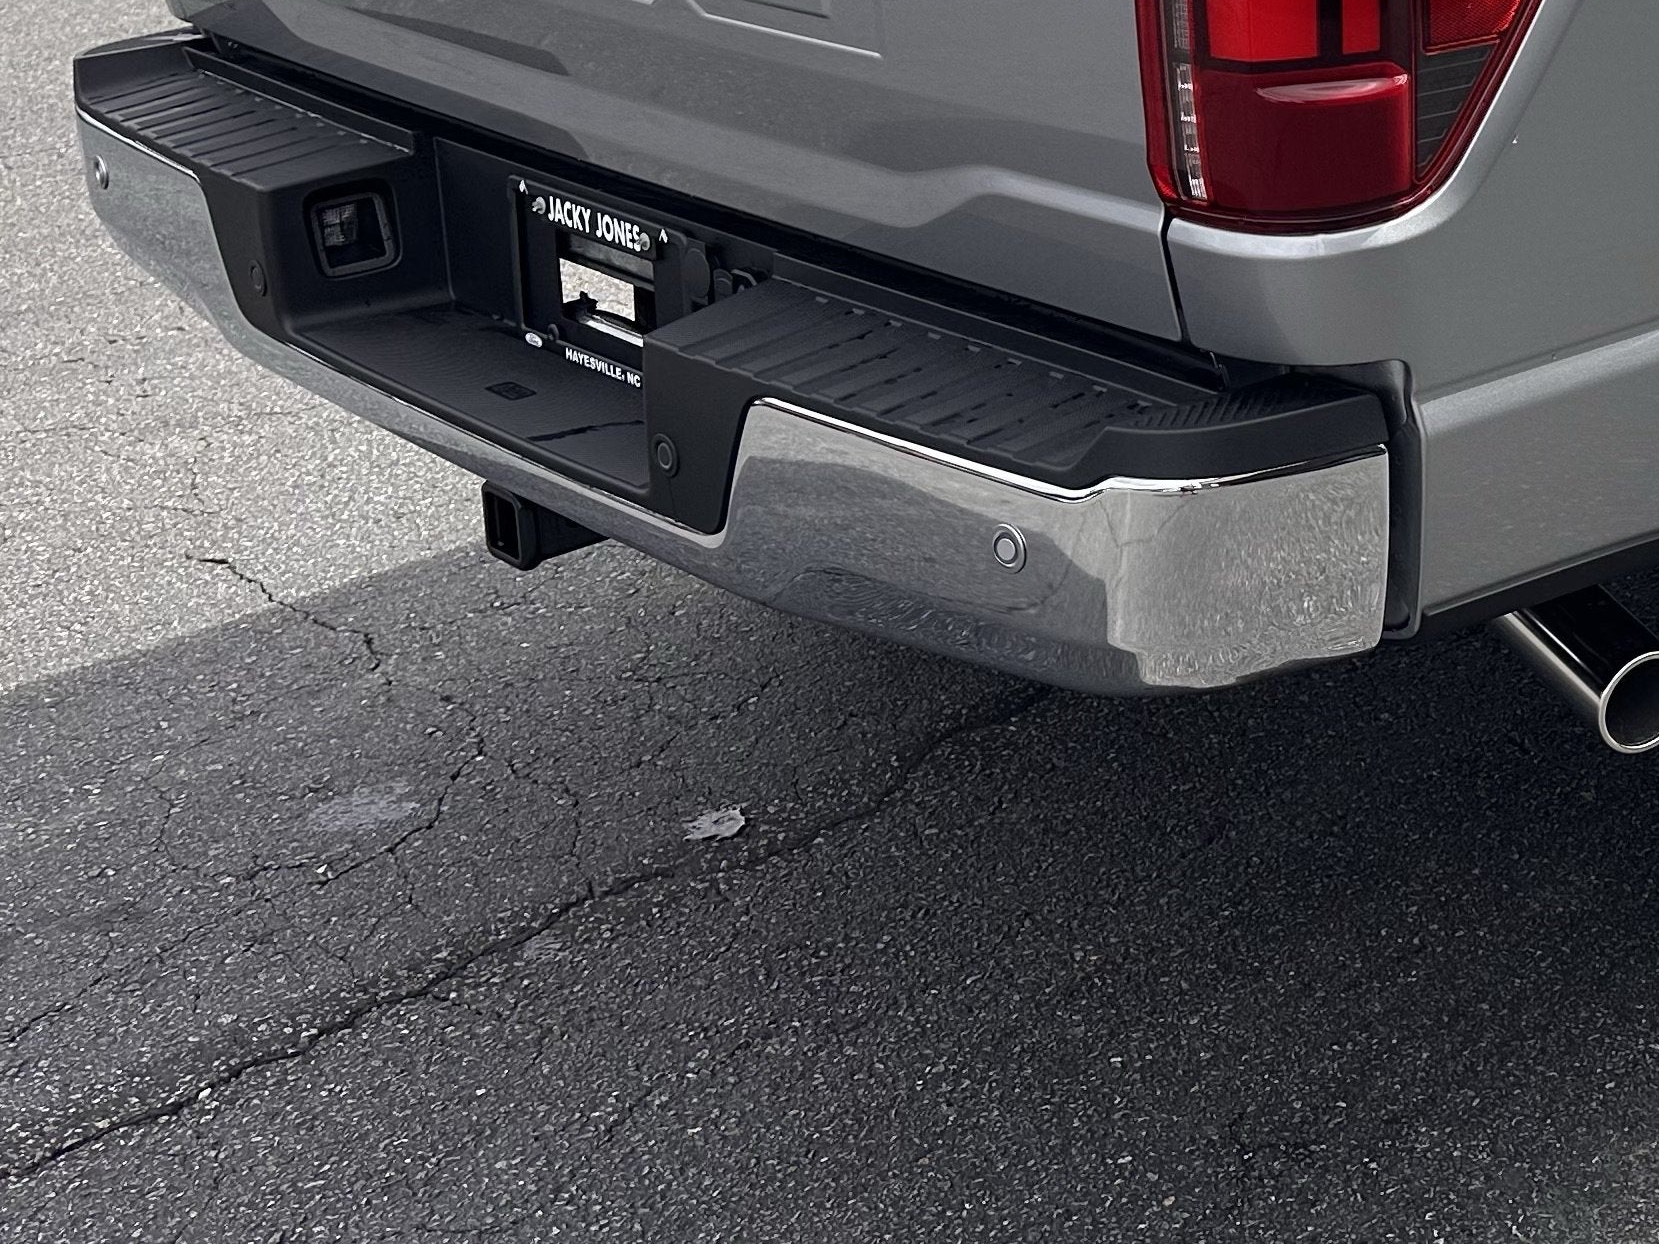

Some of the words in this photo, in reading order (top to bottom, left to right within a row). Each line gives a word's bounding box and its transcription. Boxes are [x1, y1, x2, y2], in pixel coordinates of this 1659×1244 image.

[548, 196, 592, 233] JACKY
[596, 212, 642, 252] JONES
[565, 347, 626, 382] HAYESVILLE,
[626, 370, 641, 387] NC
